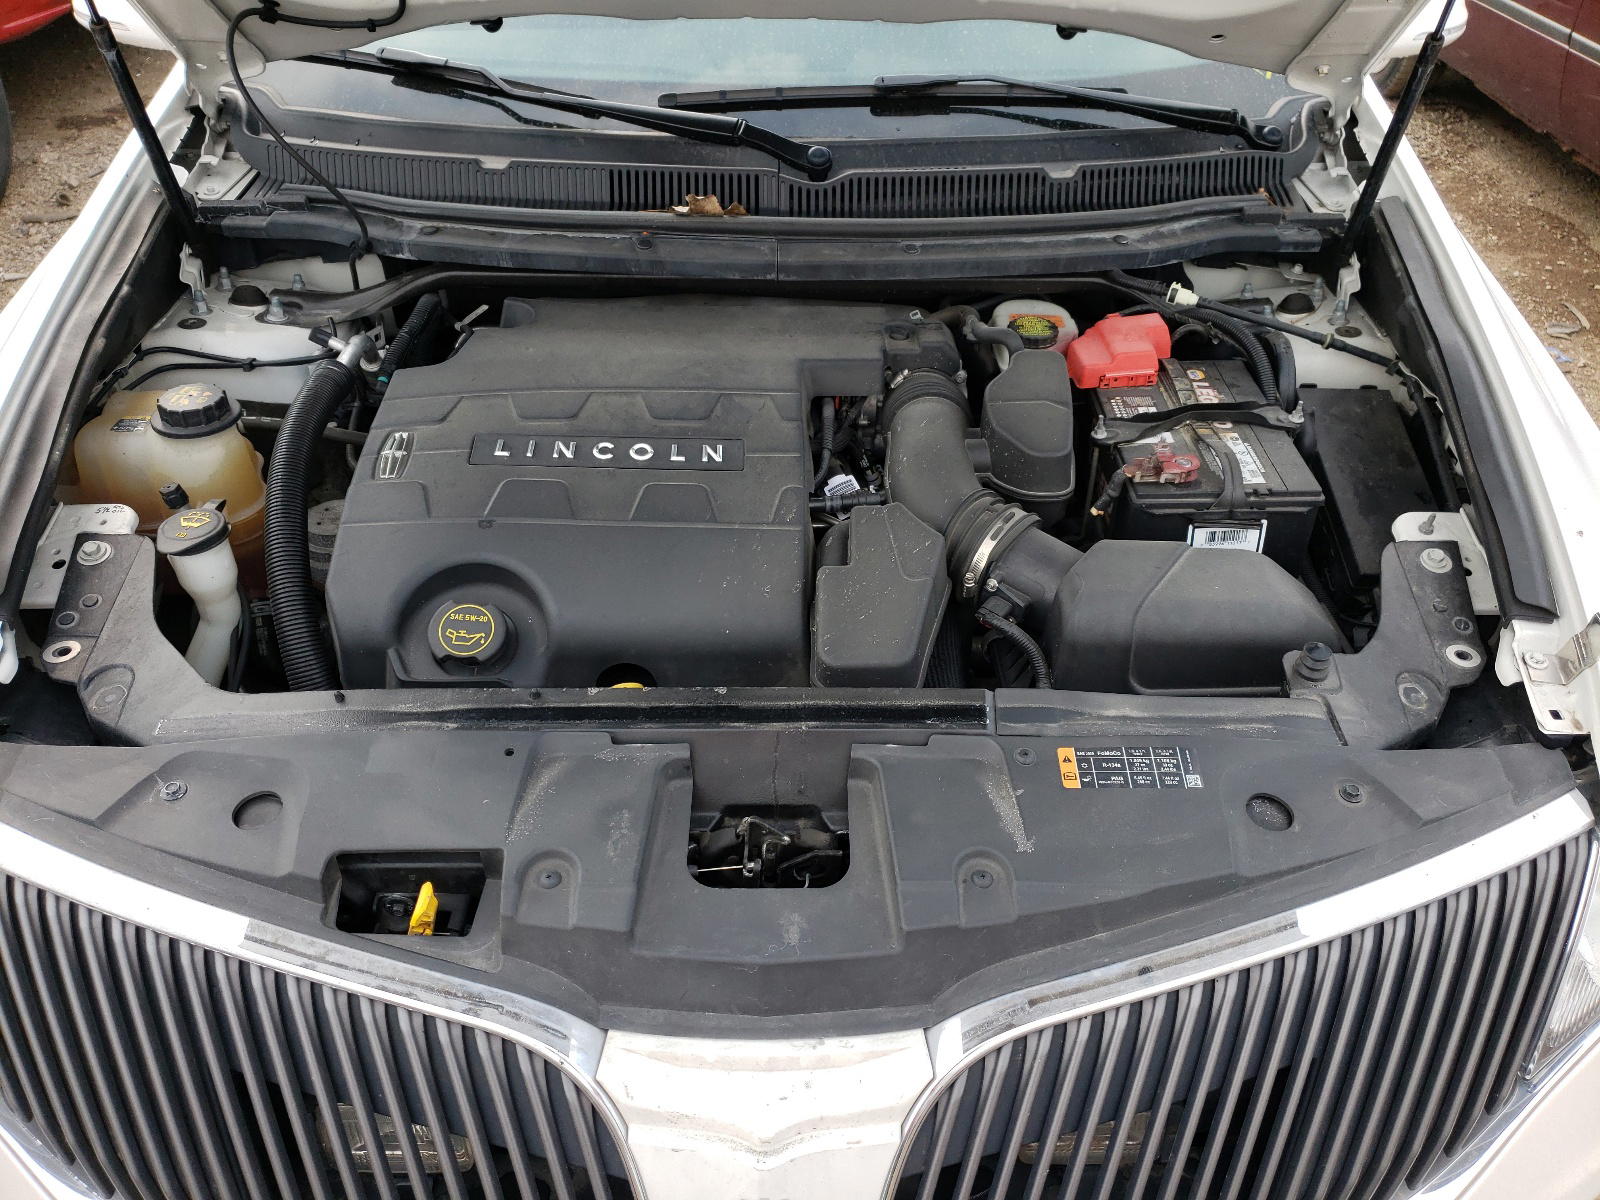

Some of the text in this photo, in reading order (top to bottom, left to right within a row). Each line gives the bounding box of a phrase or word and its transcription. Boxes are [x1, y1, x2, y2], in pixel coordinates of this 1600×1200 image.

[493, 439, 723, 463] LINCOLN
[449, 613, 488, 622] SAE 5W-20
